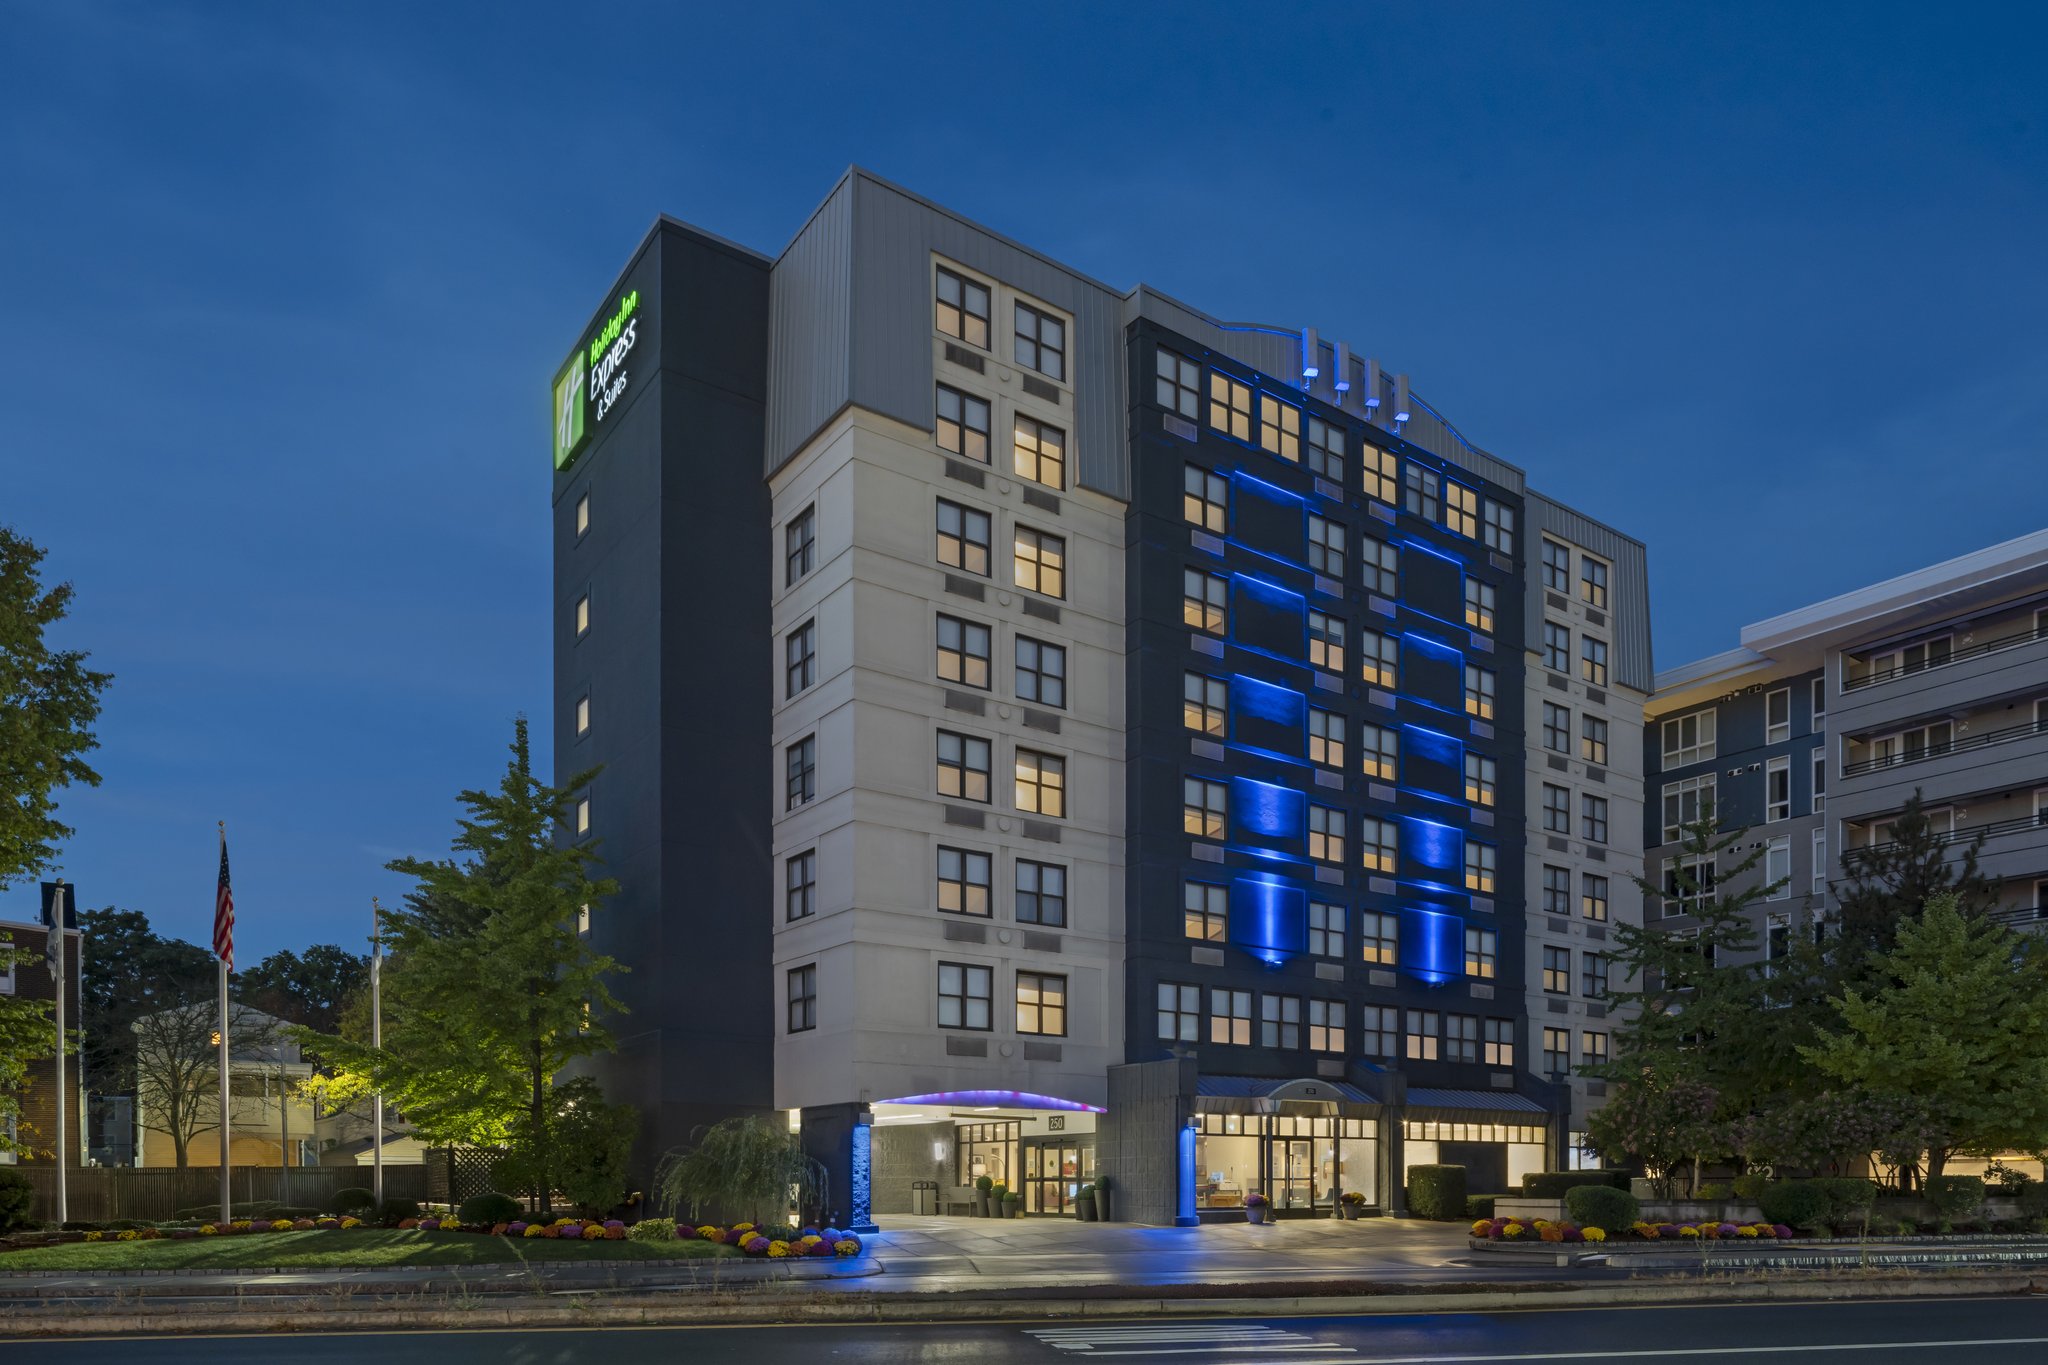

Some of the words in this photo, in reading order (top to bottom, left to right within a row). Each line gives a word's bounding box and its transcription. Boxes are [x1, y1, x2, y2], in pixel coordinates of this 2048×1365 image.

[590, 311, 621, 368] Holiday
[621, 290, 637, 323] Inn
[590, 317, 637, 402] Express
[597, 398, 604, 421] &
[603, 370, 627, 413] Suites
[1050, 1117, 1063, 1129] 250
